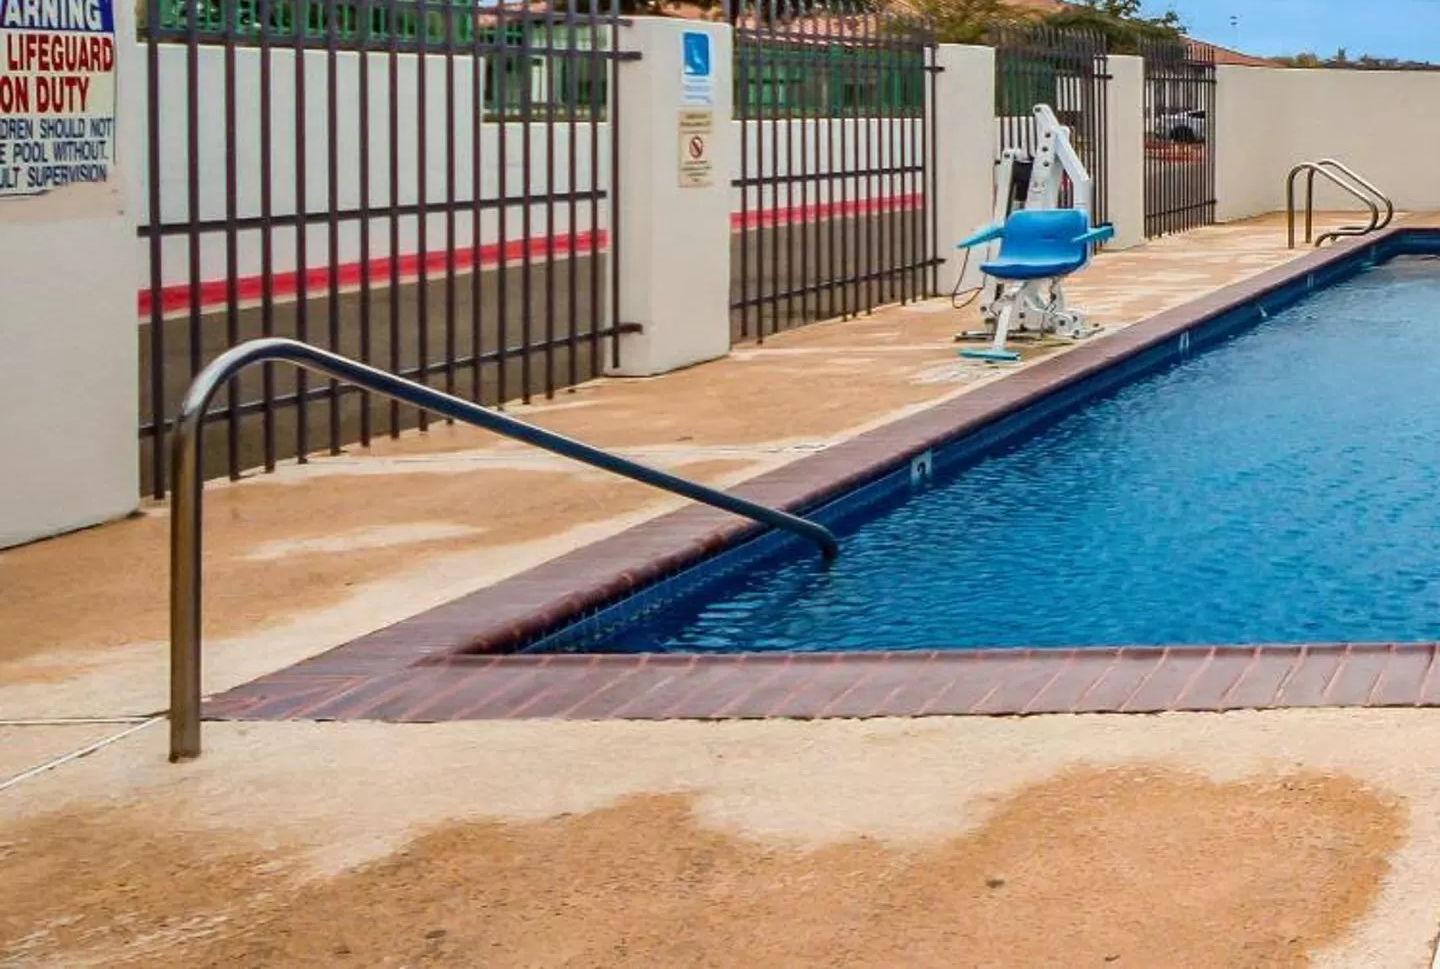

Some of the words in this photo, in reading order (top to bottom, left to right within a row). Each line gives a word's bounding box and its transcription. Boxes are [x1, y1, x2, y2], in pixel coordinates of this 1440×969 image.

[7, 33, 113, 72] LIFEGUARD
[0, 76, 29, 113] ON
[36, 76, 89, 113] DUTY
[40, 118, 84, 138] SHOULD
[90, 118, 112, 137] NOT
[13, 141, 48, 163] POOL
[28, 164, 107, 187] SUPERVISION
